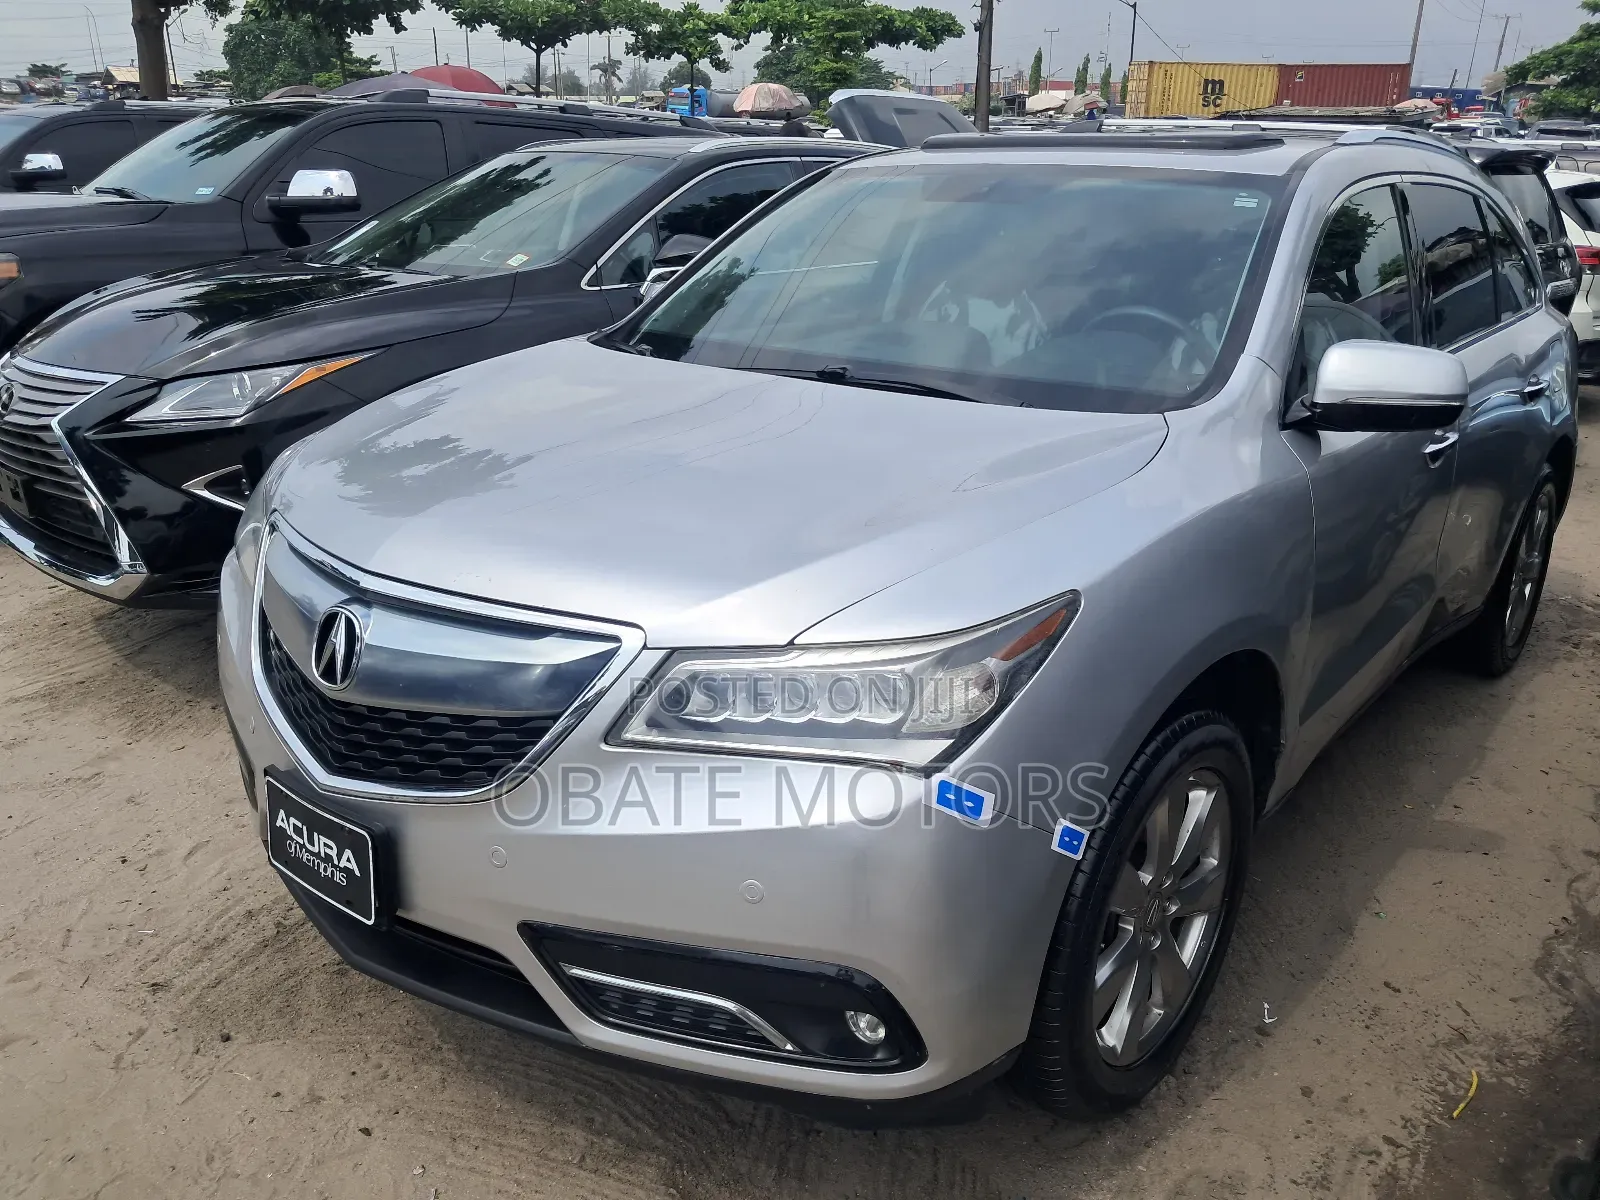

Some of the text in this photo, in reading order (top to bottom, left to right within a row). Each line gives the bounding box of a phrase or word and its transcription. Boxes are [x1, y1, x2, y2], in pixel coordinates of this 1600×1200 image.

[1201, 95, 1223, 108] SC
[275, 808, 361, 877] ACURA
[286, 839, 347, 886] of Memphis
